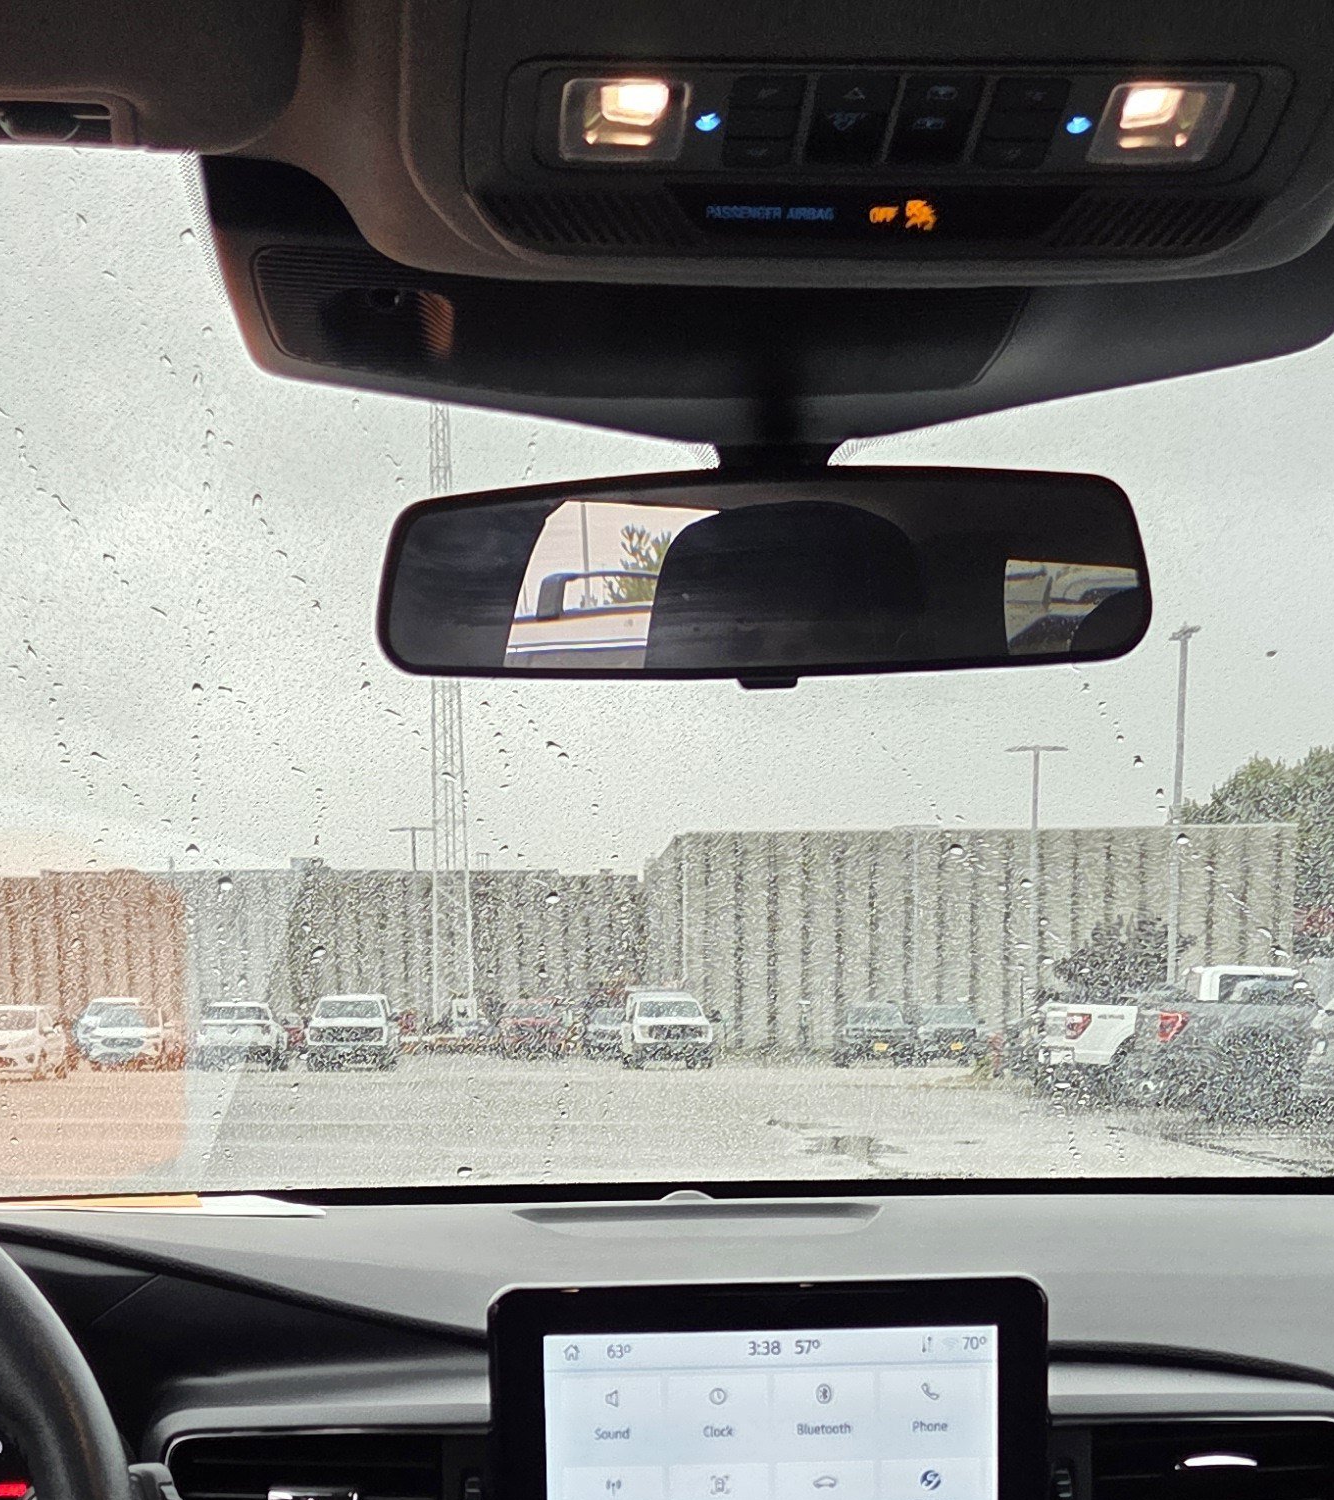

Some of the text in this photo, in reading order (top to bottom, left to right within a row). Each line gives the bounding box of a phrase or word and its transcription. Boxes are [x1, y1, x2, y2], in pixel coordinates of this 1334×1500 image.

[747, 1340, 782, 1356] 3:38
[594, 1427, 630, 1441] Sound
[703, 1425, 734, 1438] Clock
[796, 1421, 852, 1436] Bluetooth
[912, 1419, 948, 1434] Phone
